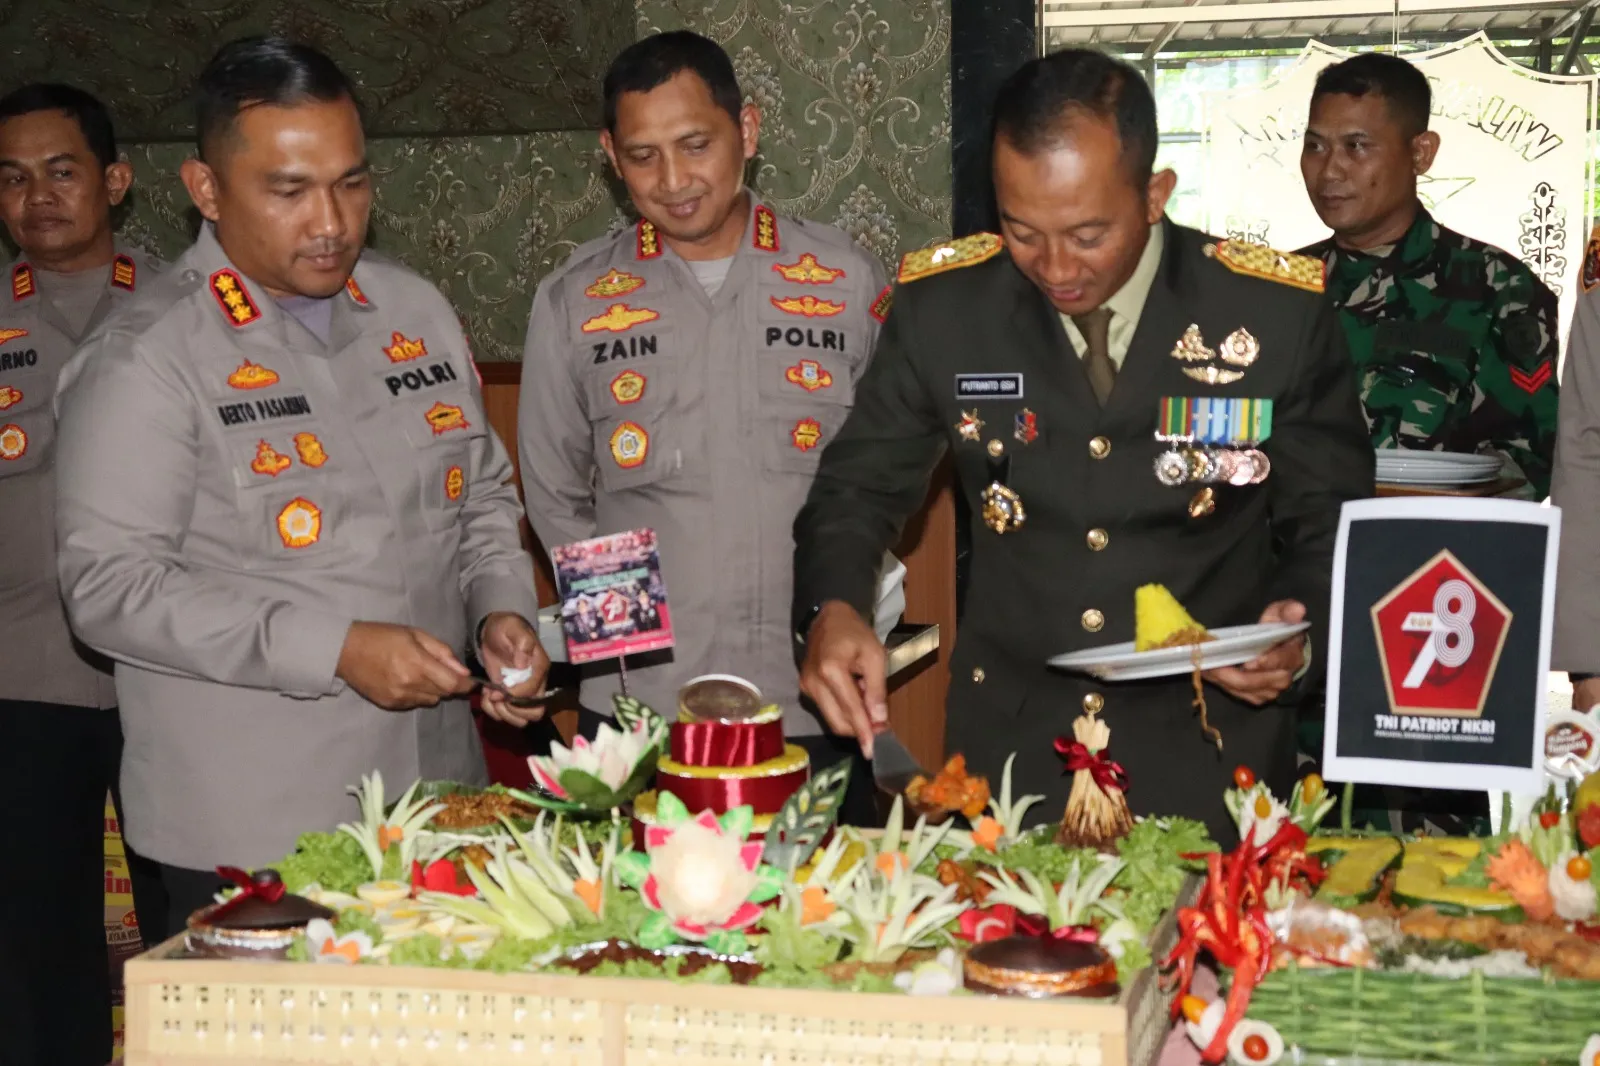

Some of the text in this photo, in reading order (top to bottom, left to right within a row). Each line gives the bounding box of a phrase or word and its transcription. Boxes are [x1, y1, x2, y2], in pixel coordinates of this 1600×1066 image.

[592, 335, 658, 365] ZAIN
[766, 327, 846, 352] POLRI
[0, 348, 38, 372] RNO
[384, 360, 457, 397] POLRI
[1401, 579, 1476, 689] 78
[1375, 714, 1495, 734] TNI PATRIOT NKRI
